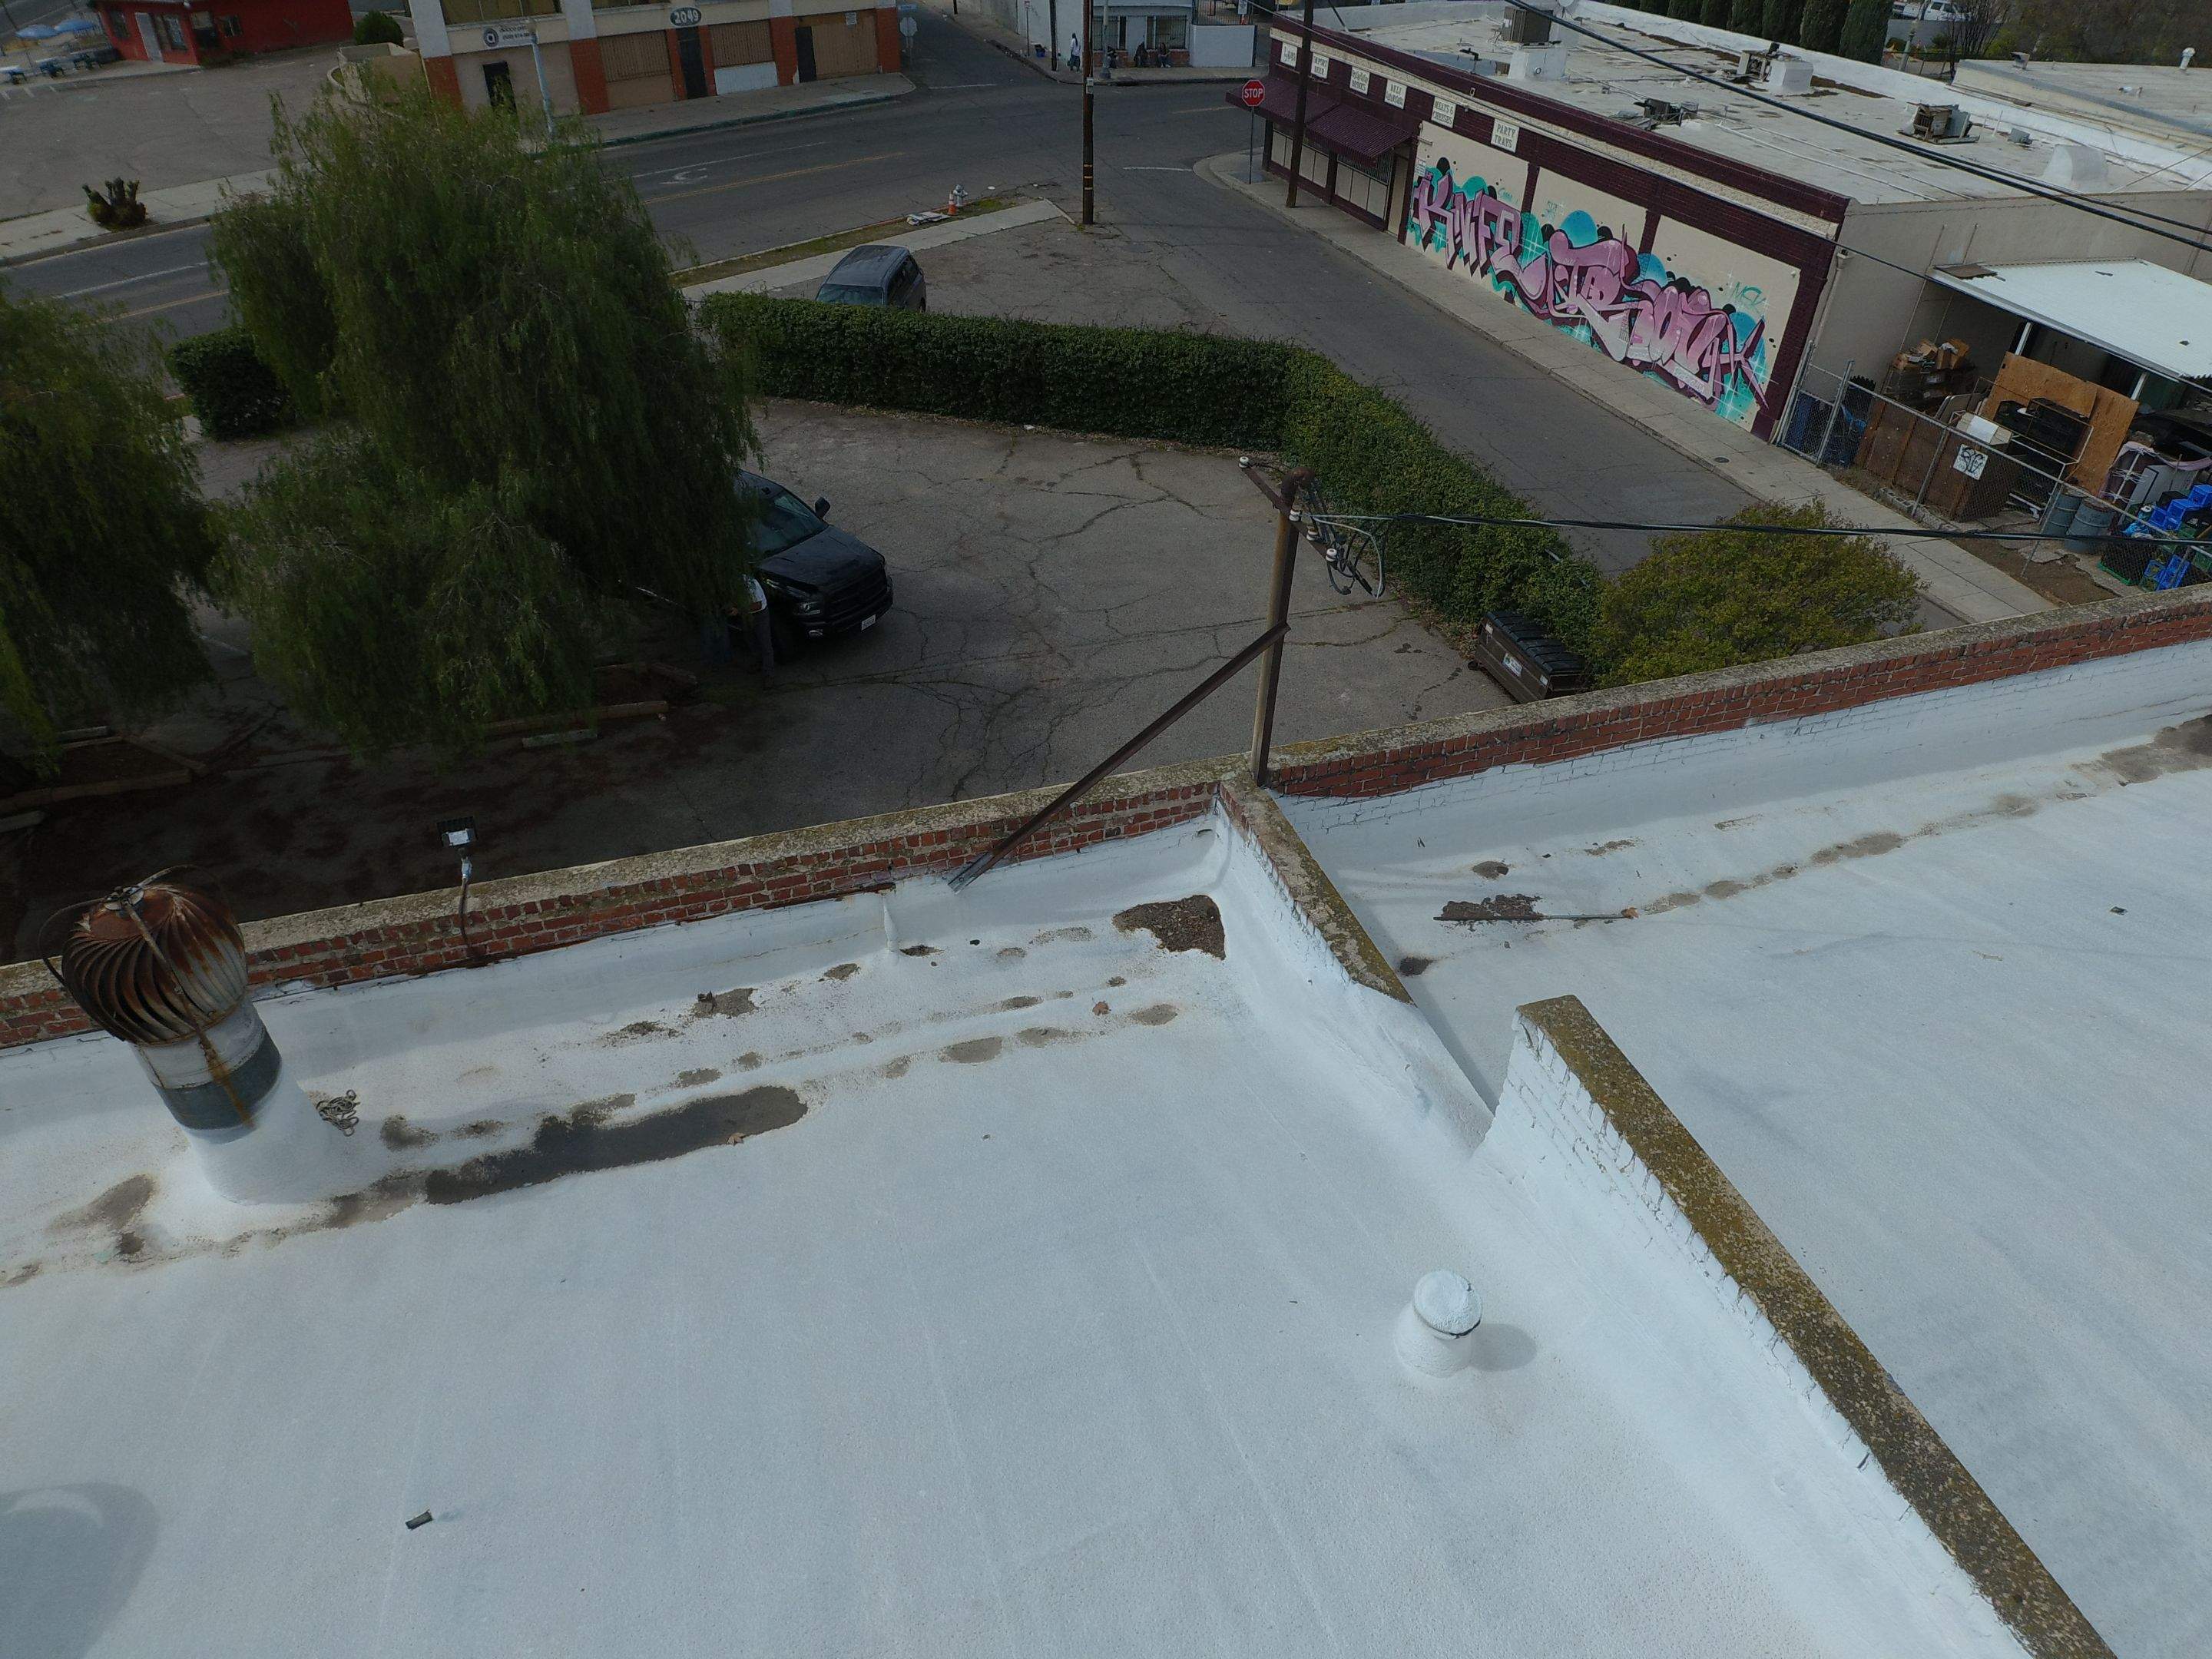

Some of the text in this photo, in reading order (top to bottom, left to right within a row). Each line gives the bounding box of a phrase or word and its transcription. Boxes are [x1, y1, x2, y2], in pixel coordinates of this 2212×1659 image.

[674, 9, 699, 23] 2049
[1244, 88, 1263, 98] STOP
[1390, 84, 1402, 94] DELI
[1496, 123, 1516, 139] PARTY
[1494, 134, 1513, 149] TRAYS
